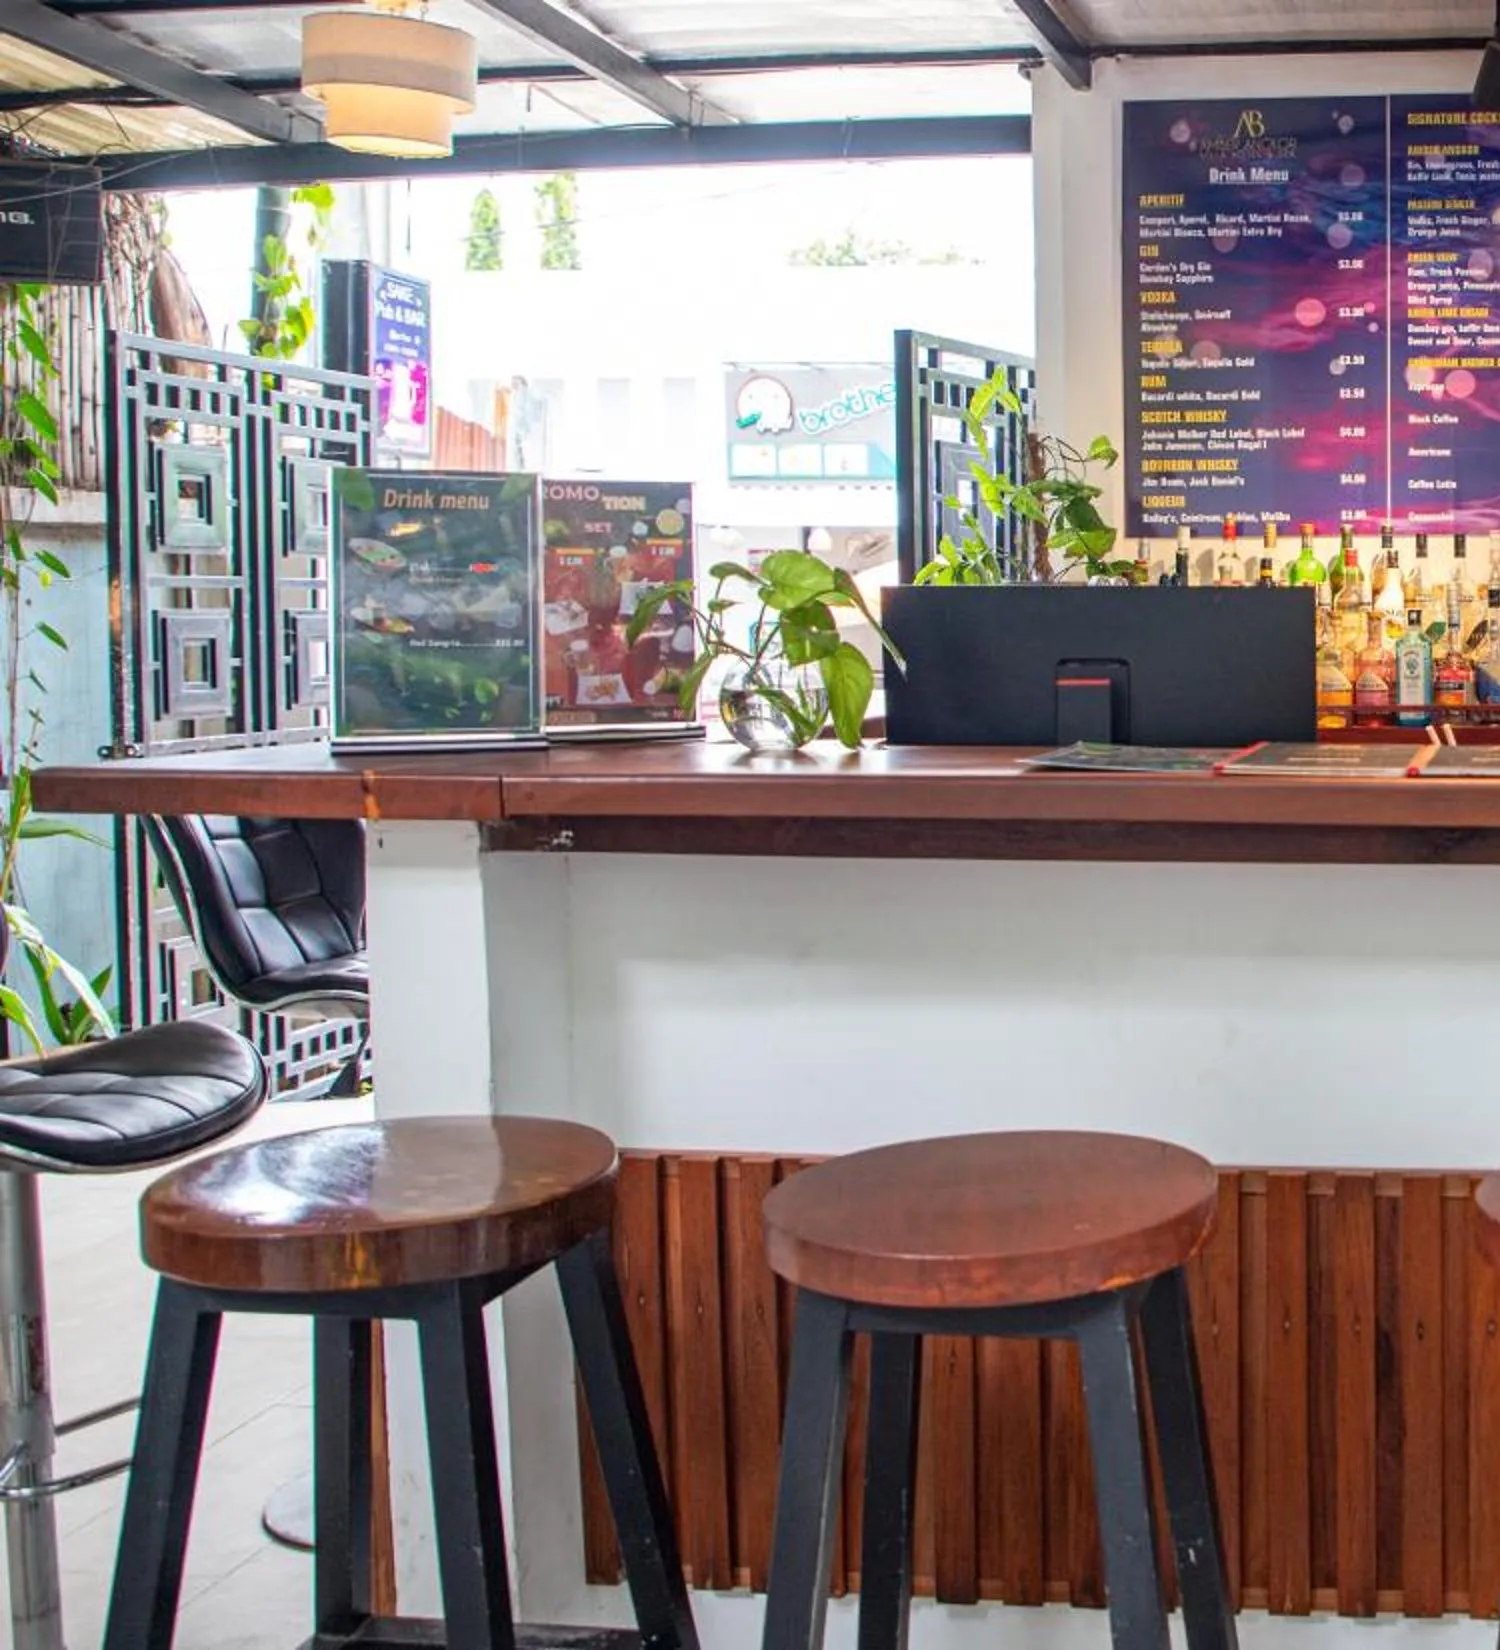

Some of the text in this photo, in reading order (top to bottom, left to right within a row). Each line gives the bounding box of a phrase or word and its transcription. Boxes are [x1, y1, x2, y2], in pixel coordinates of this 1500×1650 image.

[1209, 167, 1289, 183] Drink Menu
[383, 488, 491, 510] Drink menu
